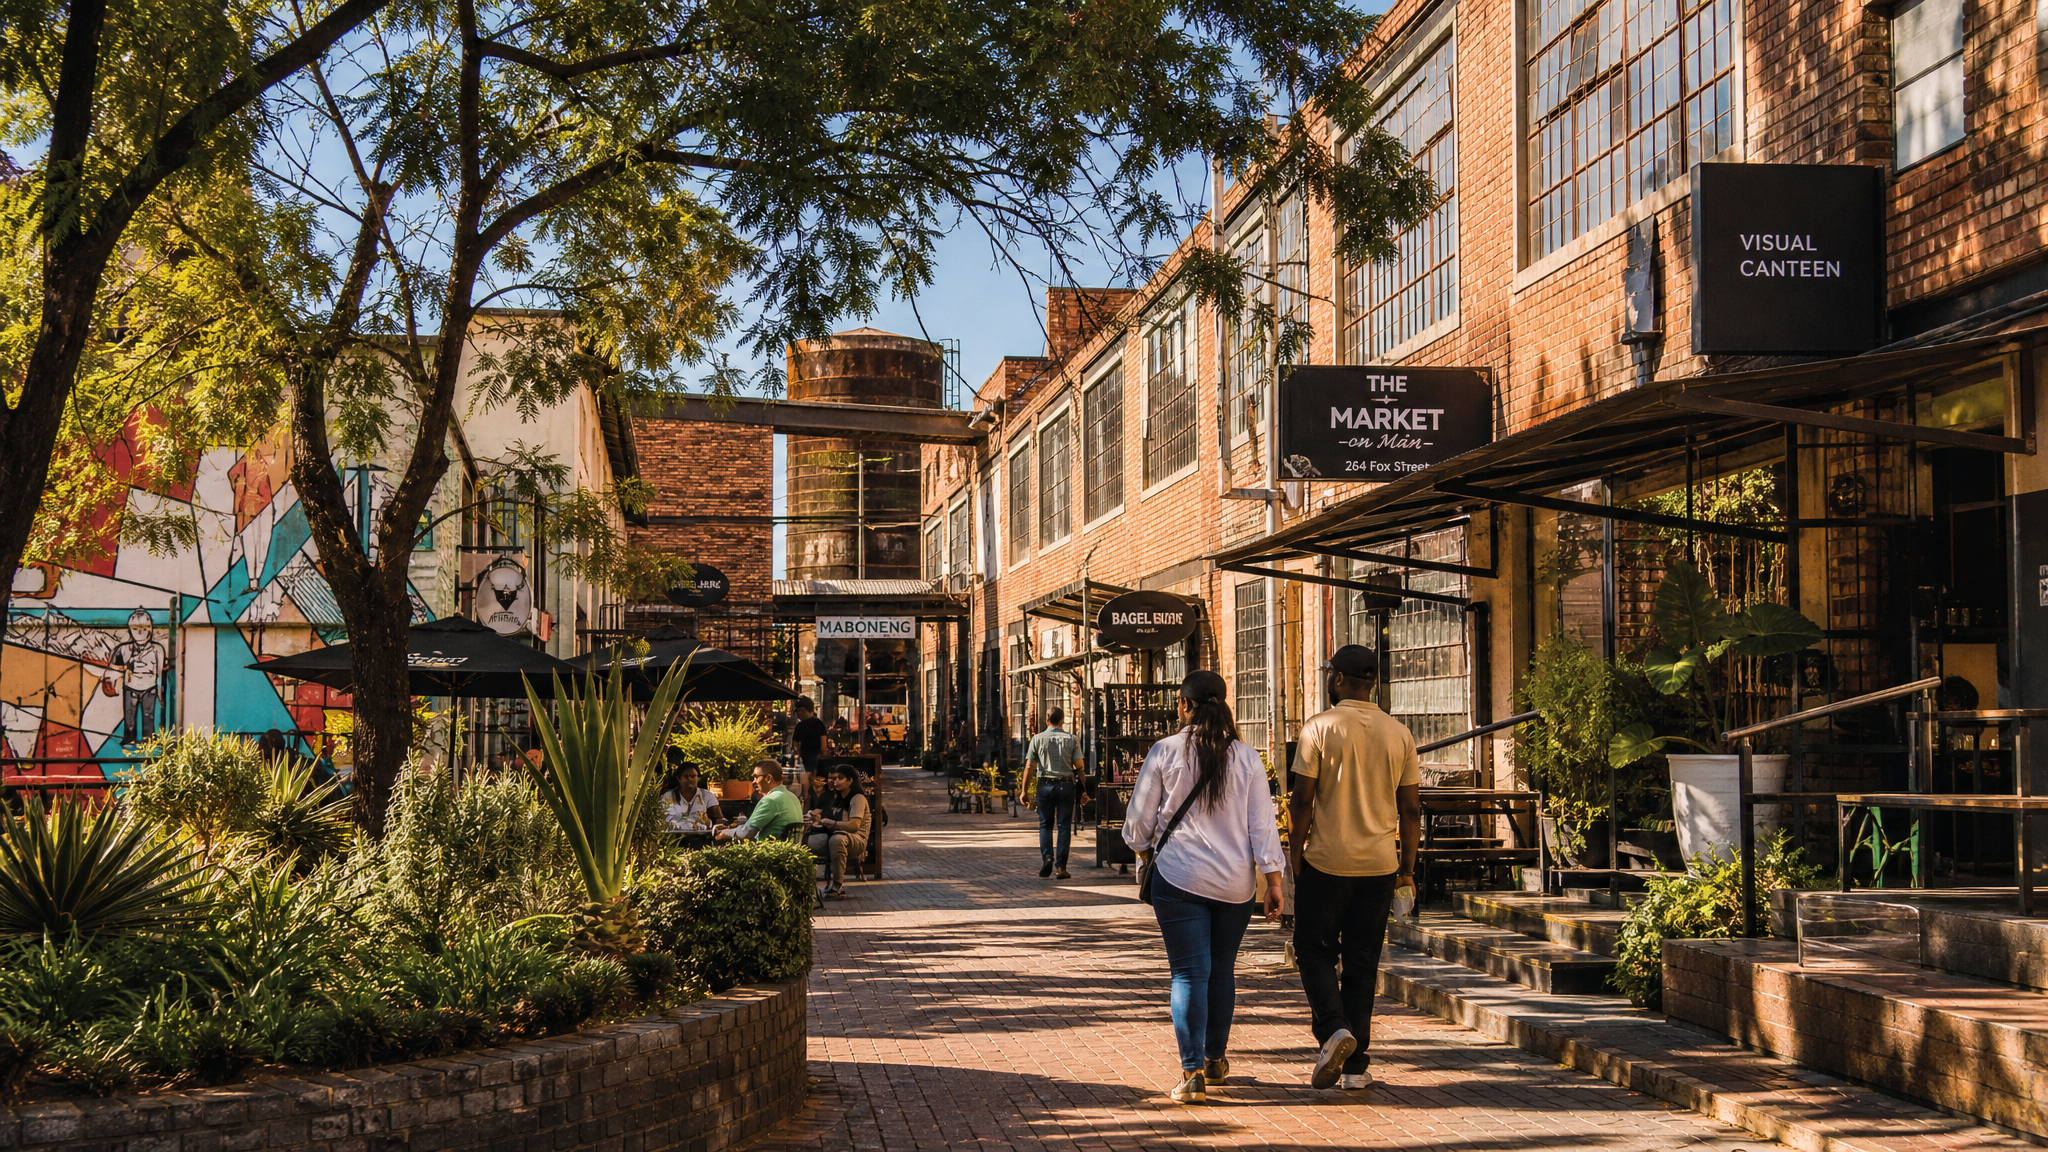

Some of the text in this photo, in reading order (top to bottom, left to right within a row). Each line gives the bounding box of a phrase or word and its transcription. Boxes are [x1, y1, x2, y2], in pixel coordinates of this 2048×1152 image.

[1740, 234, 1818, 251] VISUAL
[1740, 260, 1841, 278] CANTEEN
[1366, 375, 1408, 392] THE
[1330, 407, 1445, 431] MARKET
[1345, 460, 1367, 472] 264
[1370, 460, 1391, 472] Fox
[820, 620, 911, 634] MABONENG
[1111, 612, 1152, 625] BAGEL
